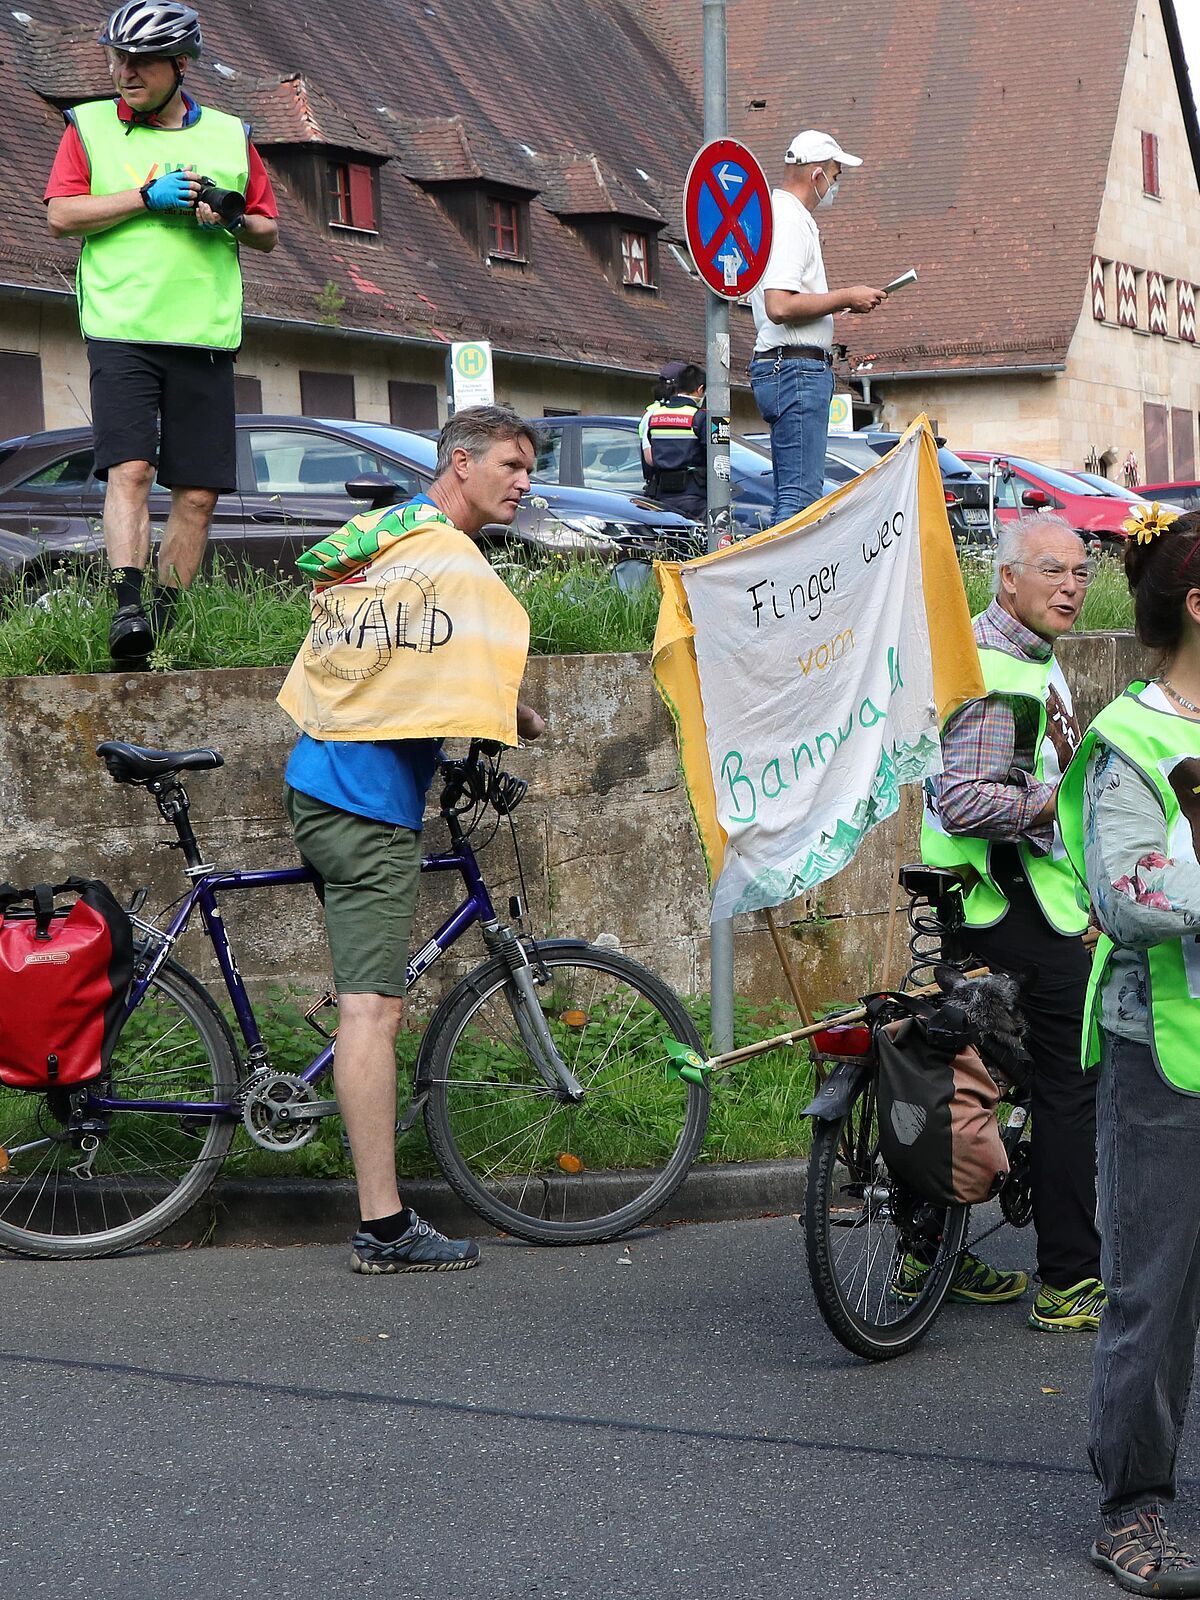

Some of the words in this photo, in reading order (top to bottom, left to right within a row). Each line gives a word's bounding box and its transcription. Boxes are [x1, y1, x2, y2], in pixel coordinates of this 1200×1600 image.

[659, 415, 689, 424] Sicherheit
[747, 562, 840, 628] Finger
[797, 626, 856, 677] vom
